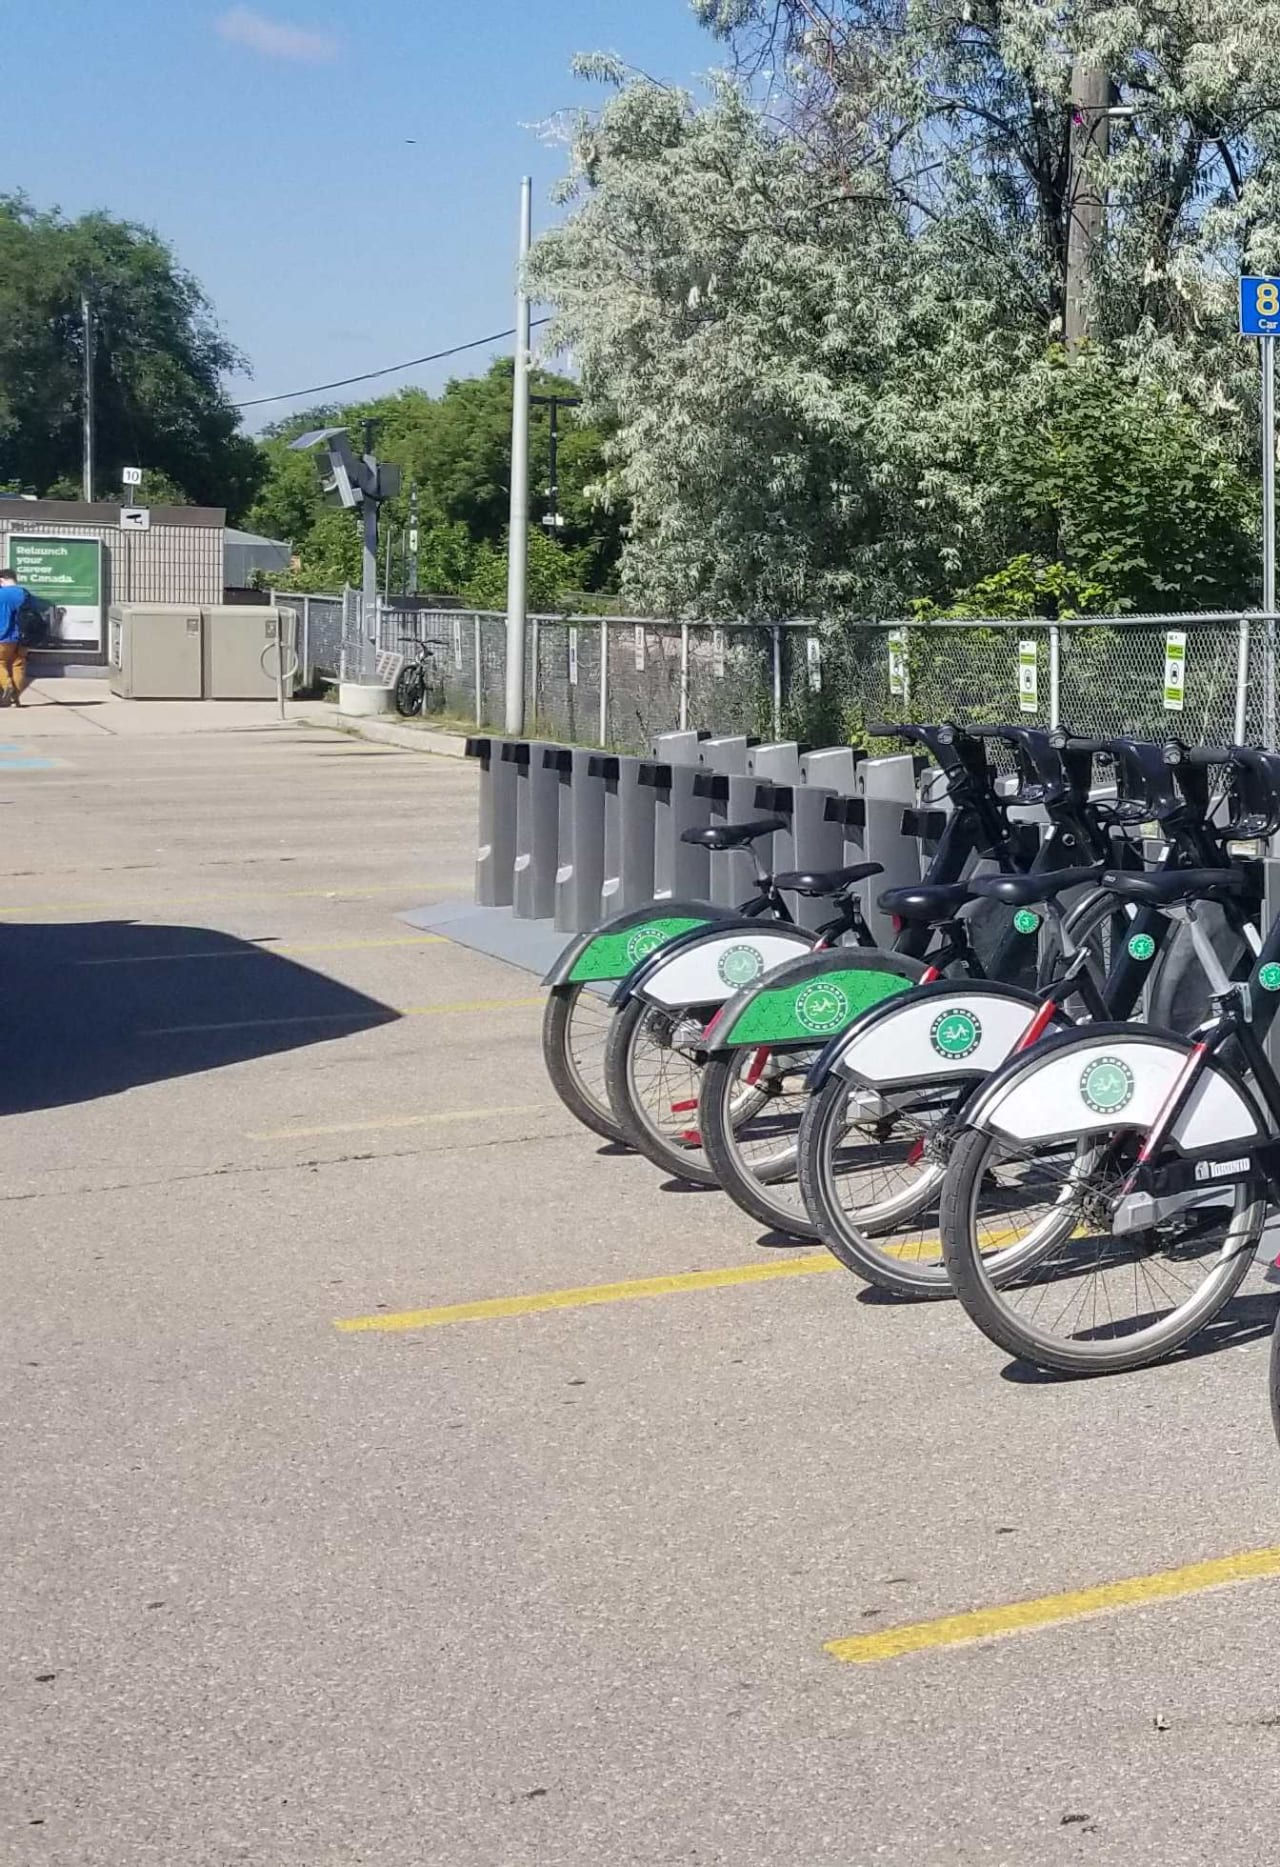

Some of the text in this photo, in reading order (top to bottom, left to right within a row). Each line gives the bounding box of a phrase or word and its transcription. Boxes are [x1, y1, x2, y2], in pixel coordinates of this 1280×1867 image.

[1256, 283, 1280, 316] 8
[1258, 319, 1278, 329] Car
[127, 470, 139, 481] 10
[16, 545, 68, 556] Relaunch
[16, 556, 43, 567] your
[16, 565, 53, 574] career
[29, 573, 75, 584] Canada.
